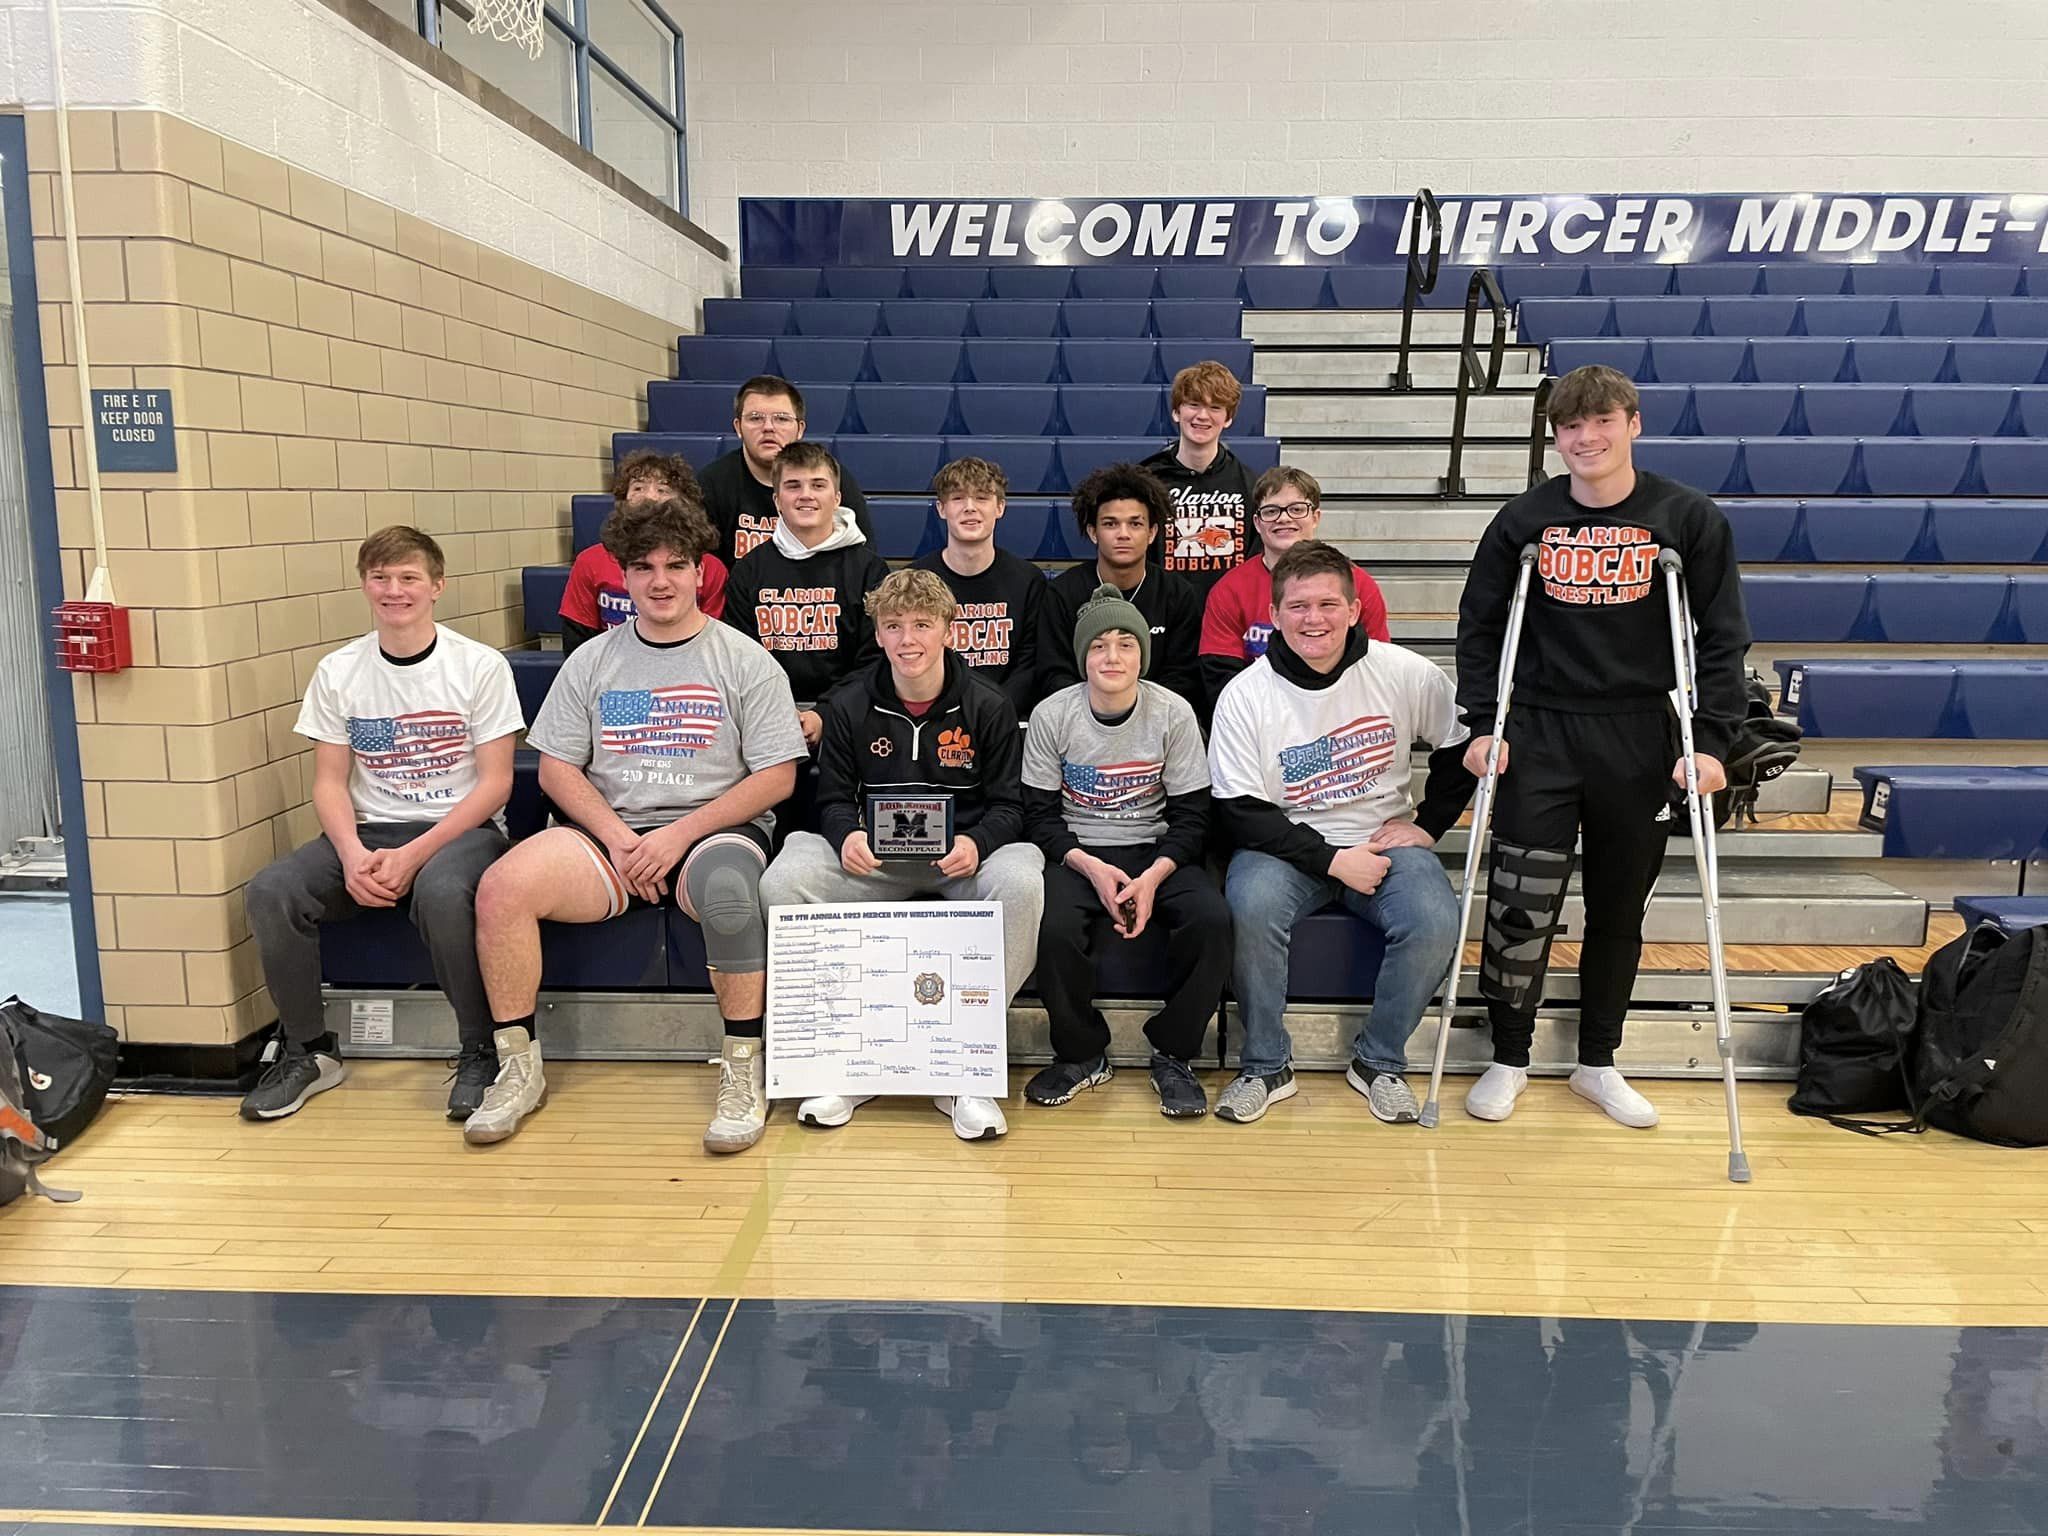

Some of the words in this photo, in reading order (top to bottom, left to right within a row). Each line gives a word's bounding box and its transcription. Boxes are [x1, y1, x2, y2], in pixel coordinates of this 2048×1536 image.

[890, 203, 1234, 256] WELCOME
[1274, 202, 1358, 256] TO
[1395, 199, 1696, 254] MERCER
[1728, 198, 2048, 253] MIDDLE-
[103, 394, 129, 408] FIRE
[100, 411, 130, 425] KEEP
[133, 411, 163, 425] DOOR
[112, 428, 156, 442] CLOSED
[1176, 504, 1245, 519] OBCATS
[739, 513, 779, 531] CLAR
[1542, 526, 1652, 545] CLARION
[1538, 542, 1660, 585] BOBCAT
[759, 588, 836, 603] CLARION
[1543, 581, 1653, 605] WRESTLING
[954, 602, 1008, 619] ARION
[755, 604, 841, 636] BOBCAT
[761, 635, 839, 651] WRESTLING
[960, 651, 1009, 667] TLING
[649, 697, 725, 719] ANNUAL
[641, 730, 706, 745] WRESTLING
[1328, 727, 1396, 752] ANNUAL
[622, 744, 697, 758] TOURNAMENT
[622, 770, 643, 782] 2ND
[647, 771, 695, 786] PLACE
[403, 788, 455, 803] PLACE
[1310, 777, 1380, 801] TOURNAMENT
[810, 912, 841, 920] ANNUAL
[863, 911, 891, 919] MERCER
